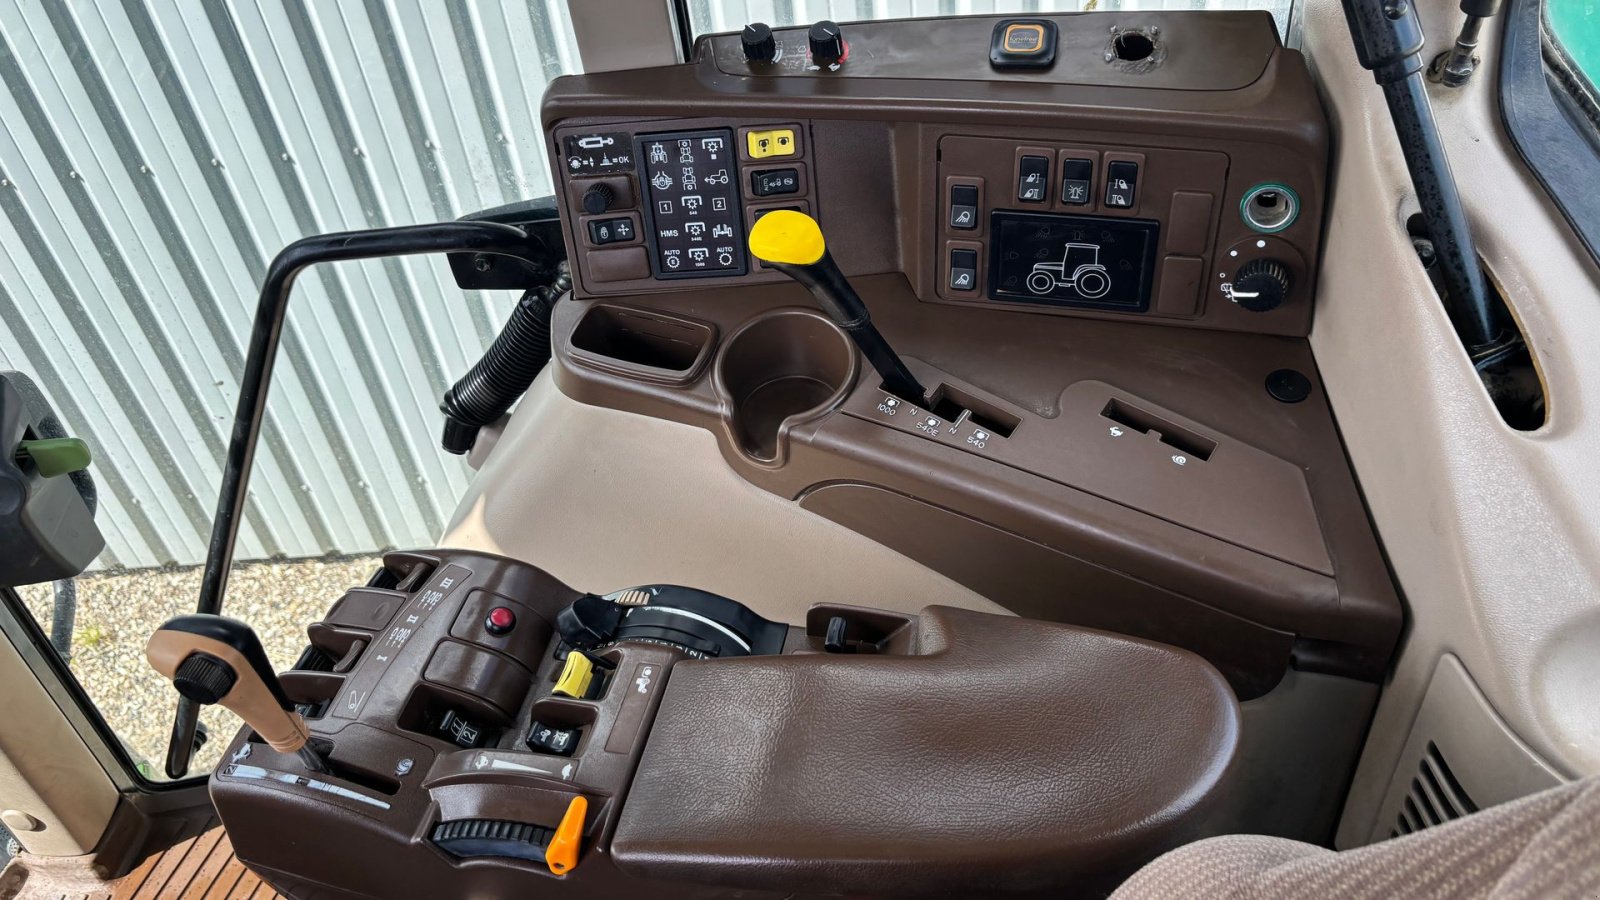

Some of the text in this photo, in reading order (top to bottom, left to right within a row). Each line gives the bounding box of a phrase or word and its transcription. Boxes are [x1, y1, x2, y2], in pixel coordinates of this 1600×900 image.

[876, 403, 896, 416] 1000
[909, 407, 918, 416] N
[915, 422, 939, 437] 540E
[948, 426, 957, 435] N
[966, 436, 986, 449] 540
